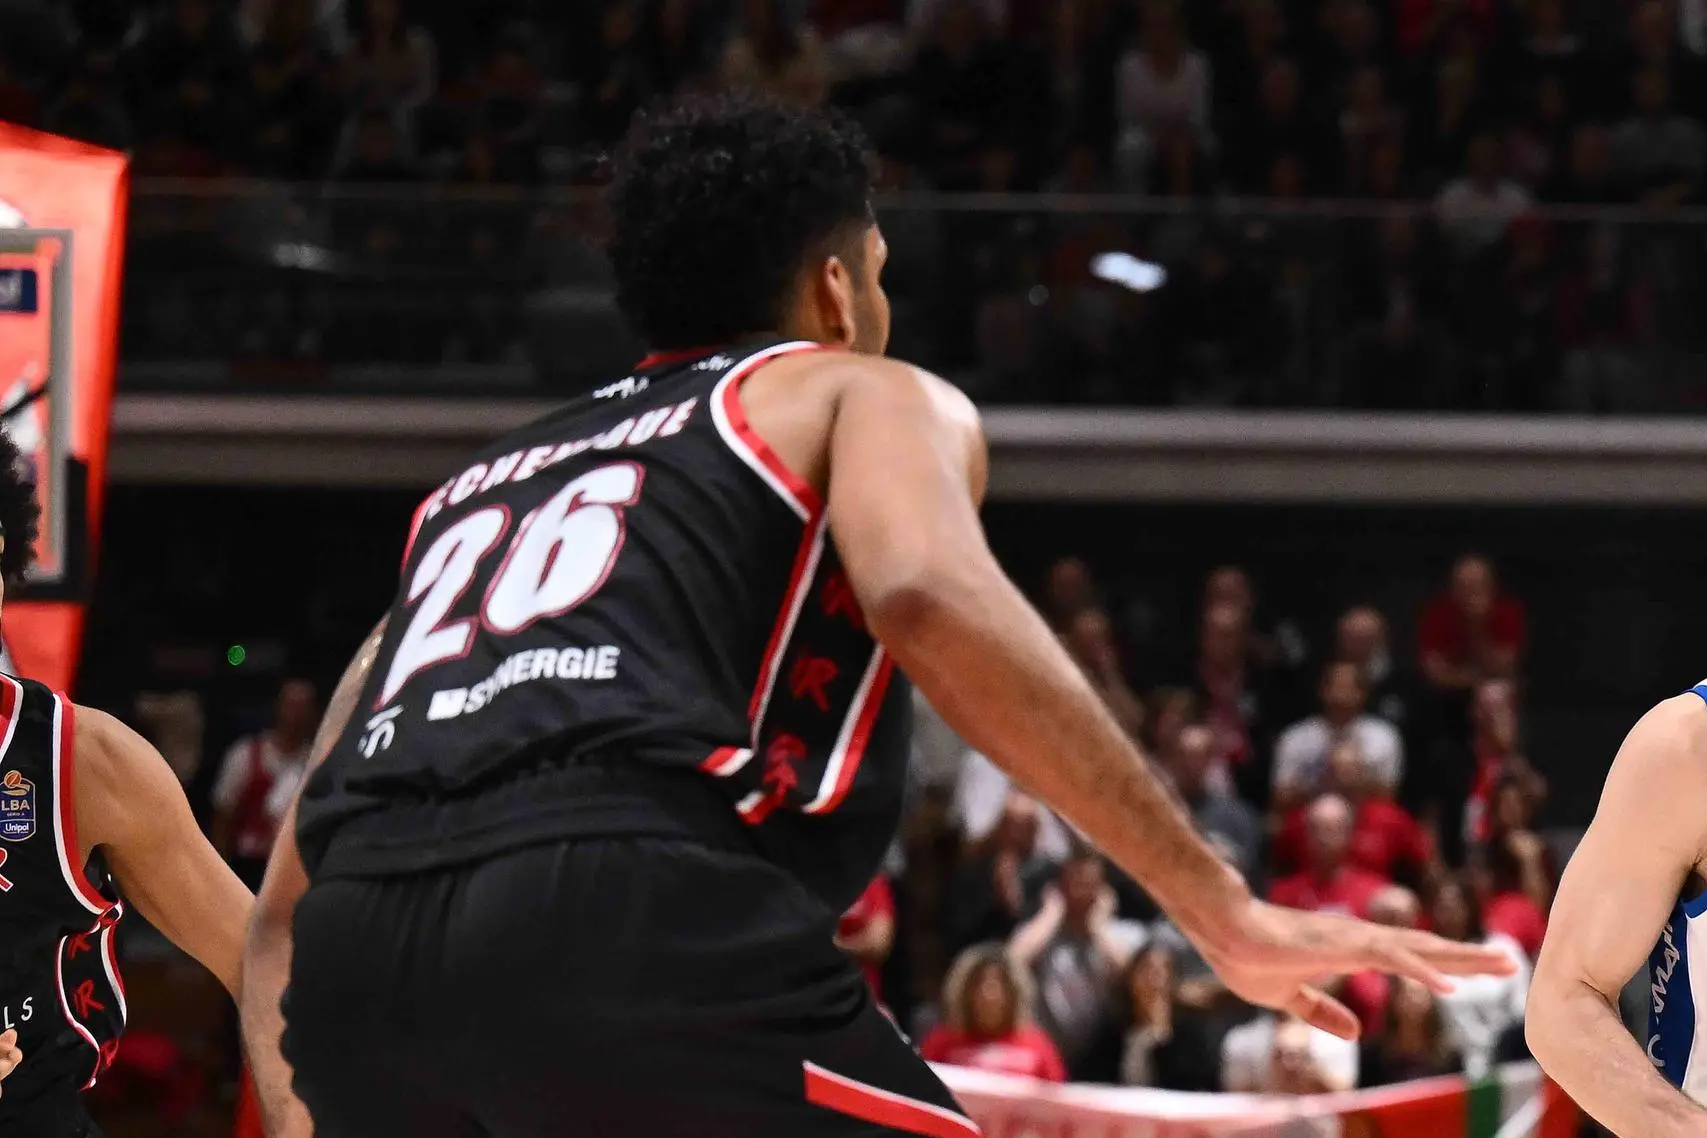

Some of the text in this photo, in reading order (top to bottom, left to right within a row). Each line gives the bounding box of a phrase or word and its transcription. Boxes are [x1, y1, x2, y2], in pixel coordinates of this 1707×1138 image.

[373, 460, 646, 712] 26
[1, 799, 31, 811] LBA
[5, 822, 30, 834] Unipol
